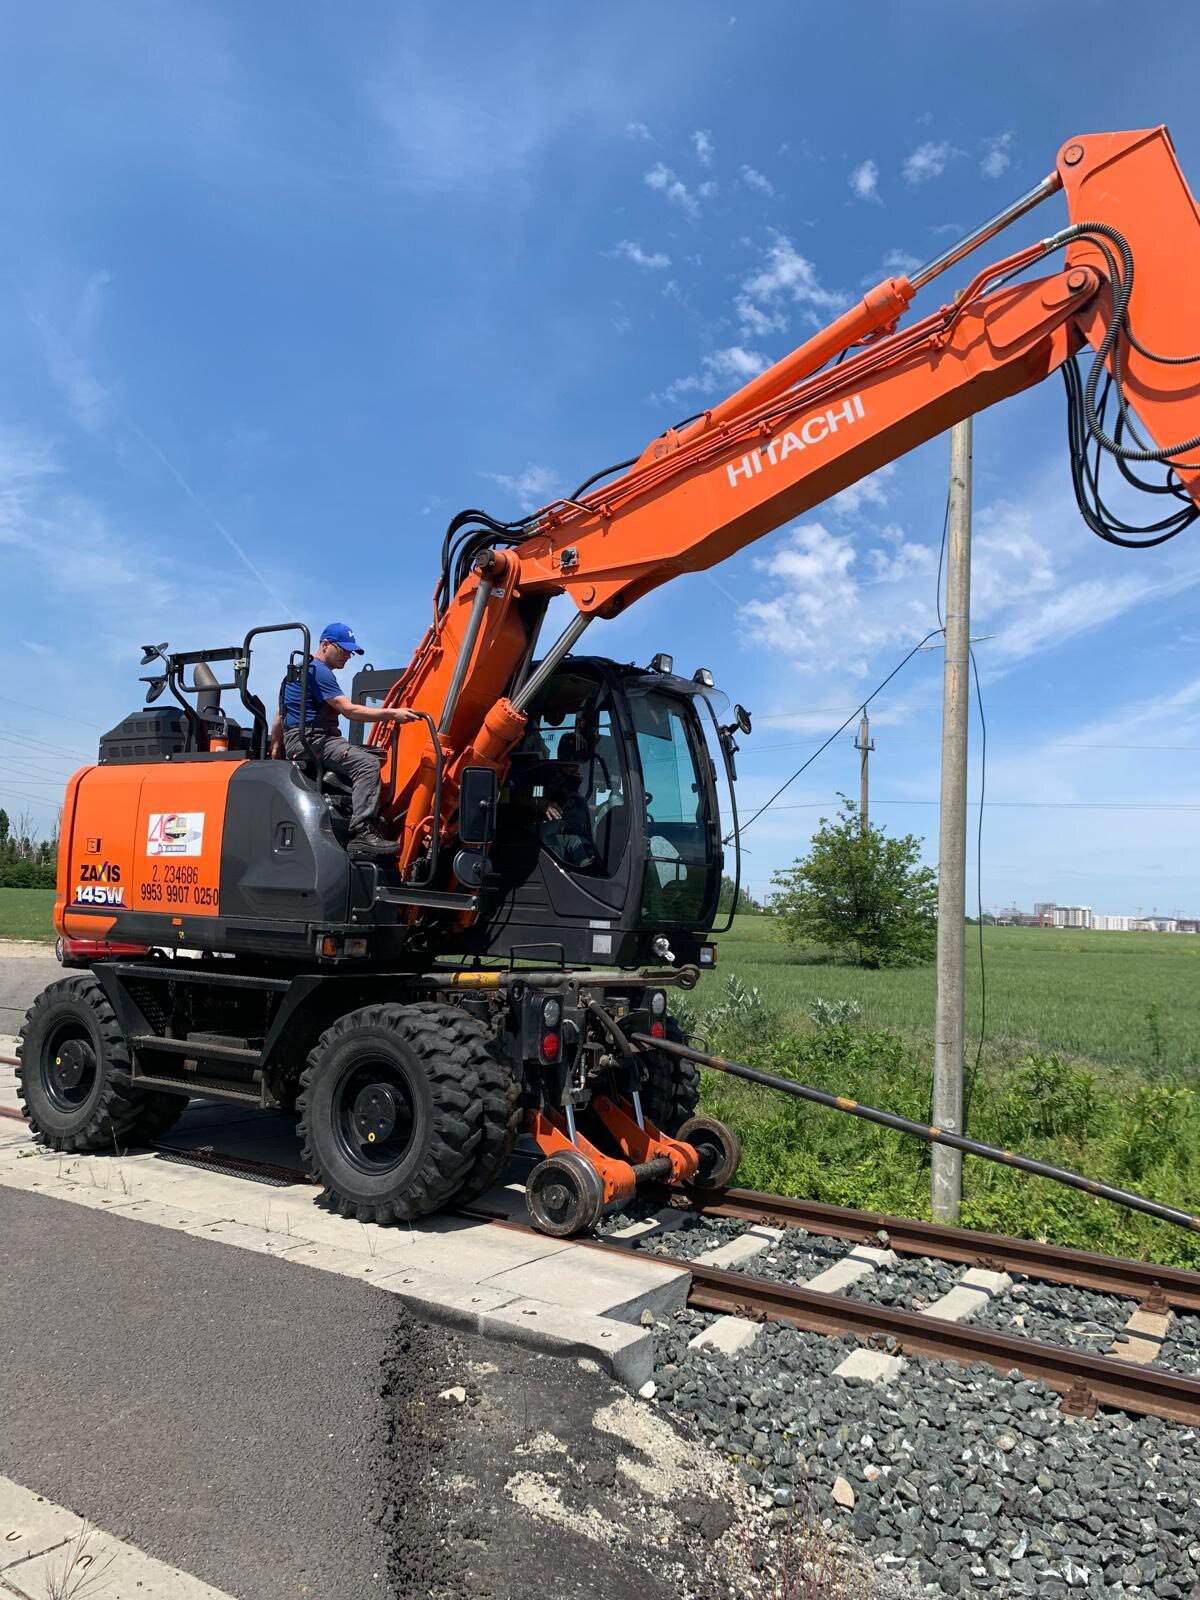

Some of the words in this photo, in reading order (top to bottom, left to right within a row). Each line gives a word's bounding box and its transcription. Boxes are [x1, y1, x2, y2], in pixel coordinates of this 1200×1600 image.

[726, 395, 865, 488] HITACHI
[80, 861, 120, 882] ZAXIS
[164, 865, 199, 884] 234686
[75, 885, 124, 904] 145W
[141, 884, 162, 901] 9953
[167, 887, 189, 904] 9907
